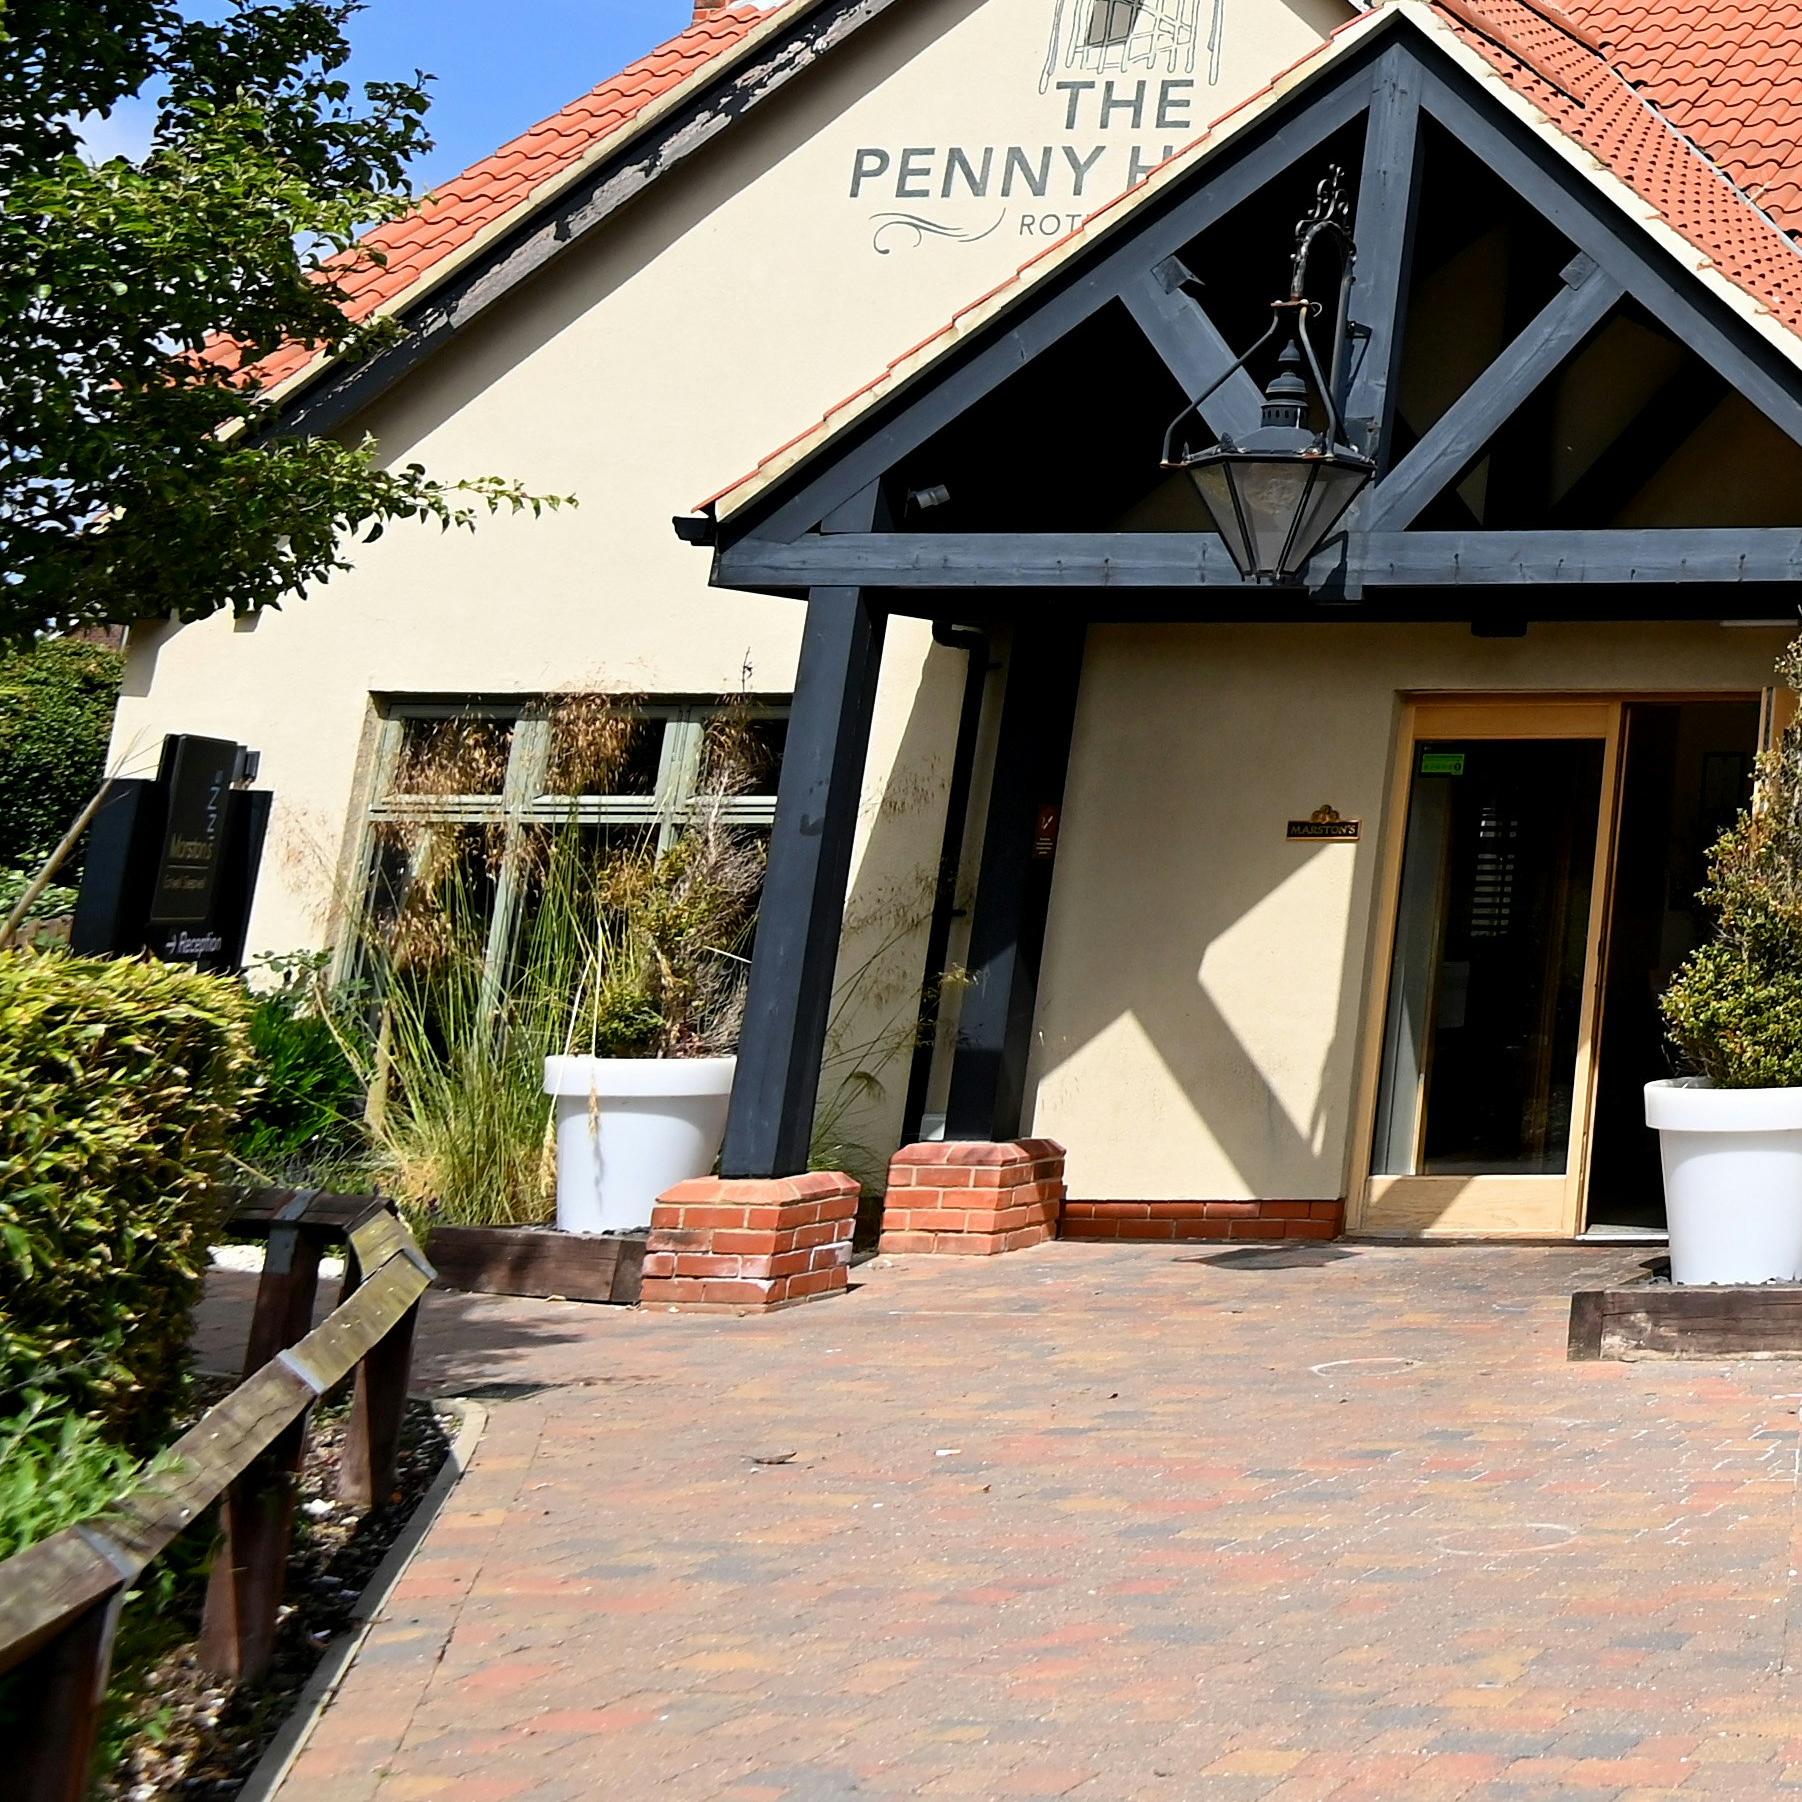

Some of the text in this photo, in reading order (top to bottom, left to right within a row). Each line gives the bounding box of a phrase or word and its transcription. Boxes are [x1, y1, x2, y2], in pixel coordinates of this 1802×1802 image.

[1055, 78, 1195, 130] THE
[849, 144, 1174, 198] PENNY H
[1019, 213, 1083, 236] ROT
[1290, 824, 1356, 835] MARSTON'S
[177, 930, 222, 958] Reception
